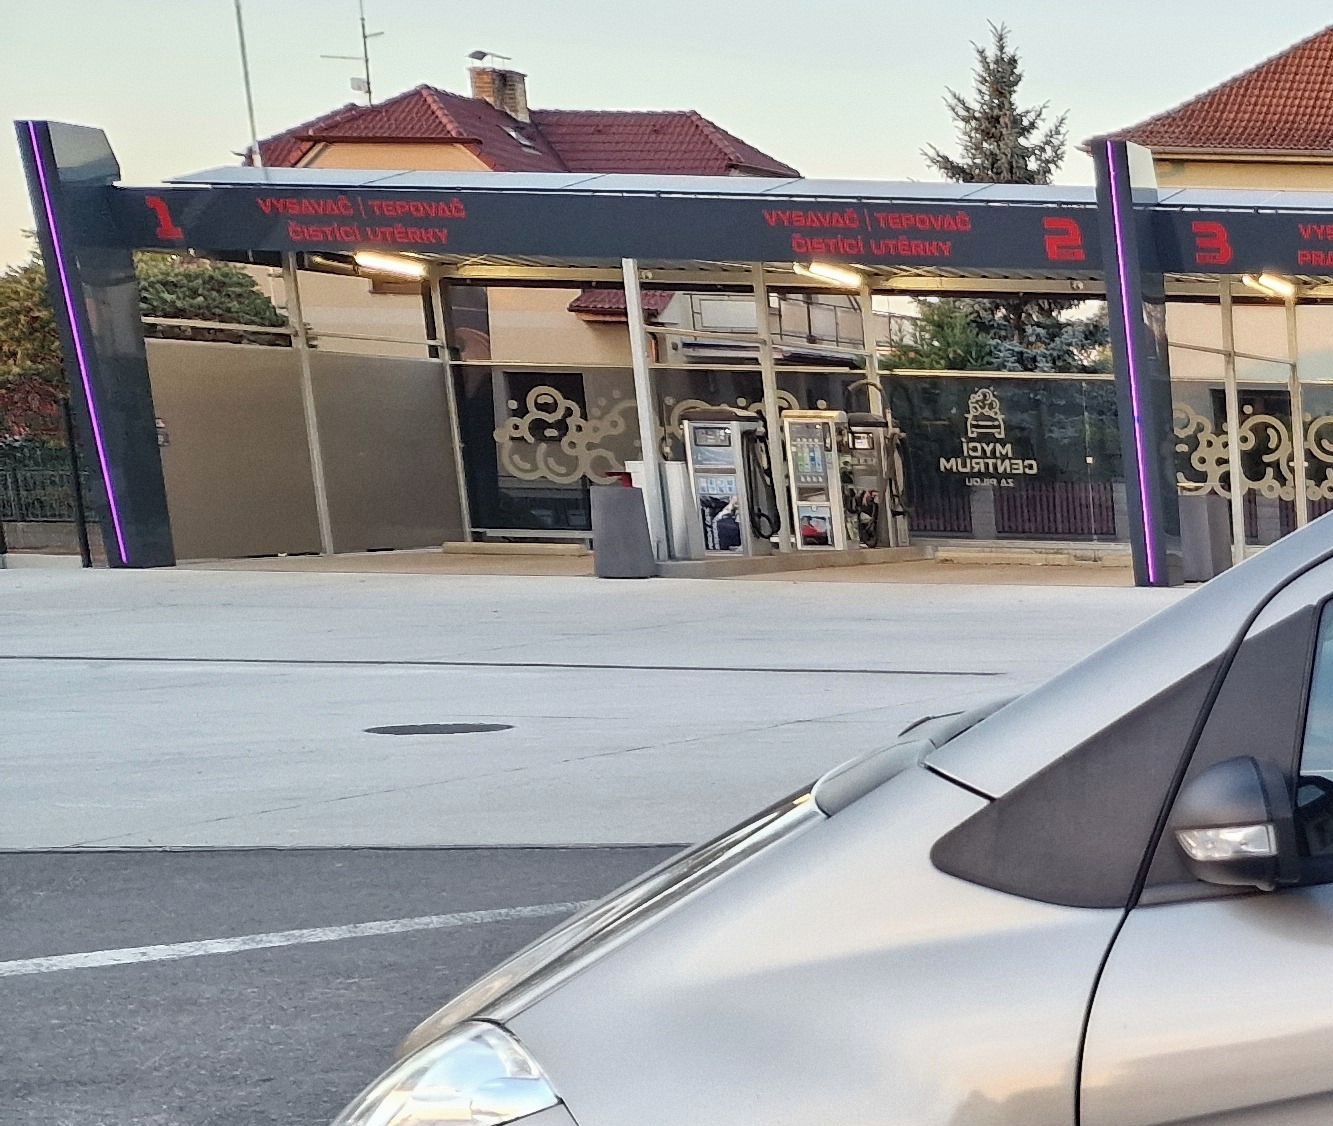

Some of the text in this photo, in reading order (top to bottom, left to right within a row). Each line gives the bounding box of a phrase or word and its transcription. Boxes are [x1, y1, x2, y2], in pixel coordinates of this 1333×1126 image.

[145, 196, 185, 240] 1
[257, 195, 354, 215] VYSAVAČ
[368, 198, 467, 219] TEPOVAČ
[288, 220, 360, 242] ČISTÍCÍ
[762, 208, 859, 229] VYSAVAČ
[874, 211, 971, 232] TEPOVAČ
[791, 233, 864, 254] ČISTÍCÍ
[1043, 217, 1085, 261] 2
[1191, 220, 1233, 266] 3
